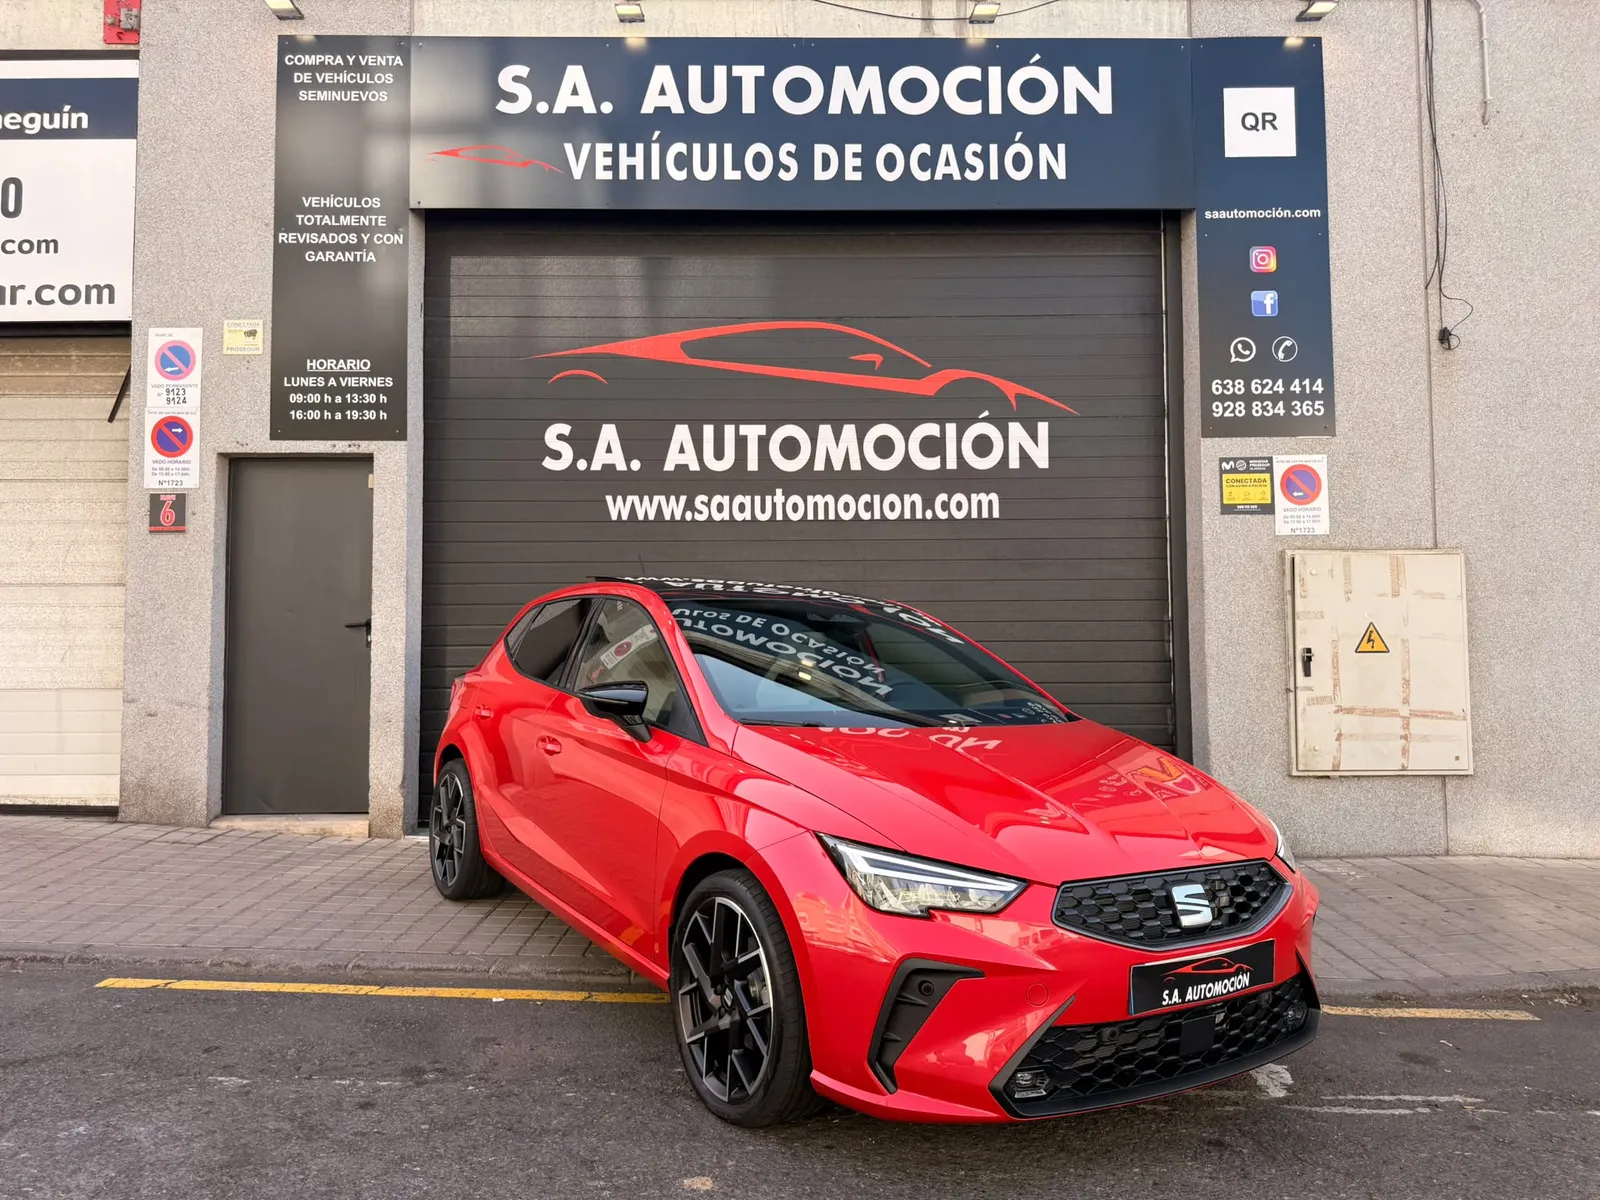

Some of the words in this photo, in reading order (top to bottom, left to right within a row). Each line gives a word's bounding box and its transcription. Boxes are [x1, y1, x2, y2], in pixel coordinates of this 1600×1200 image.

[285, 55, 344, 66] COMPRA
[347, 55, 356, 66] Y
[359, 55, 404, 66] VENTA
[293, 73, 312, 83] DE
[315, 70, 394, 84] VEHÍCULOS
[495, 65, 613, 115] S.A.
[640, 53, 1113, 115] AUTOMOCIÓN
[299, 90, 388, 102] SEMINUEVOS
[1241, 112, 1278, 132] QR
[563, 130, 798, 181] VEHÍCULOS
[813, 143, 863, 181] DE
[876, 131, 1067, 182] OCASIÓN
[302, 194, 381, 209] VEHÍCULOS
[1204, 207, 1321, 219] saautomoción.com
[296, 215, 387, 226] TOTALMENTE
[278, 232, 358, 244] REVISADOS
[361, 233, 371, 244] Y
[373, 233, 404, 245] CON
[305, 249, 377, 262] GARANTÍA
[306, 359, 371, 371] HORARIO
[284, 377, 325, 387] LUNES
[327, 377, 338, 387] A
[339, 377, 393, 387] VIERNES
[1211, 379, 1245, 395] 638
[1250, 379, 1284, 394] 624
[1290, 378, 1324, 394] 414
[166, 388, 186, 396] 9123
[289, 393, 321, 404] 09:00
[324, 393, 331, 403] h
[334, 396, 342, 404] a
[345, 393, 376, 404] 13:30
[380, 393, 387, 403] h
[166, 397, 187, 405] 9124
[289, 410, 321, 420] 16:00
[324, 410, 331, 419] h
[334, 412, 342, 420] a
[345, 410, 376, 420] 19:30
[380, 410, 387, 419] h
[1212, 401, 1246, 417] 928
[1252, 401, 1285, 417] 834
[1291, 400, 1325, 416] 365
[541, 422, 641, 472] S.A.
[663, 410, 1050, 473] AUTOMOCIÓN
[605, 488, 1001, 522] www.saautomocion.com
[160, 500, 175, 526] 6
[1161, 988, 1182, 1006] S.A.
[1185, 971, 1251, 1002] AUTOMOCIÓN
